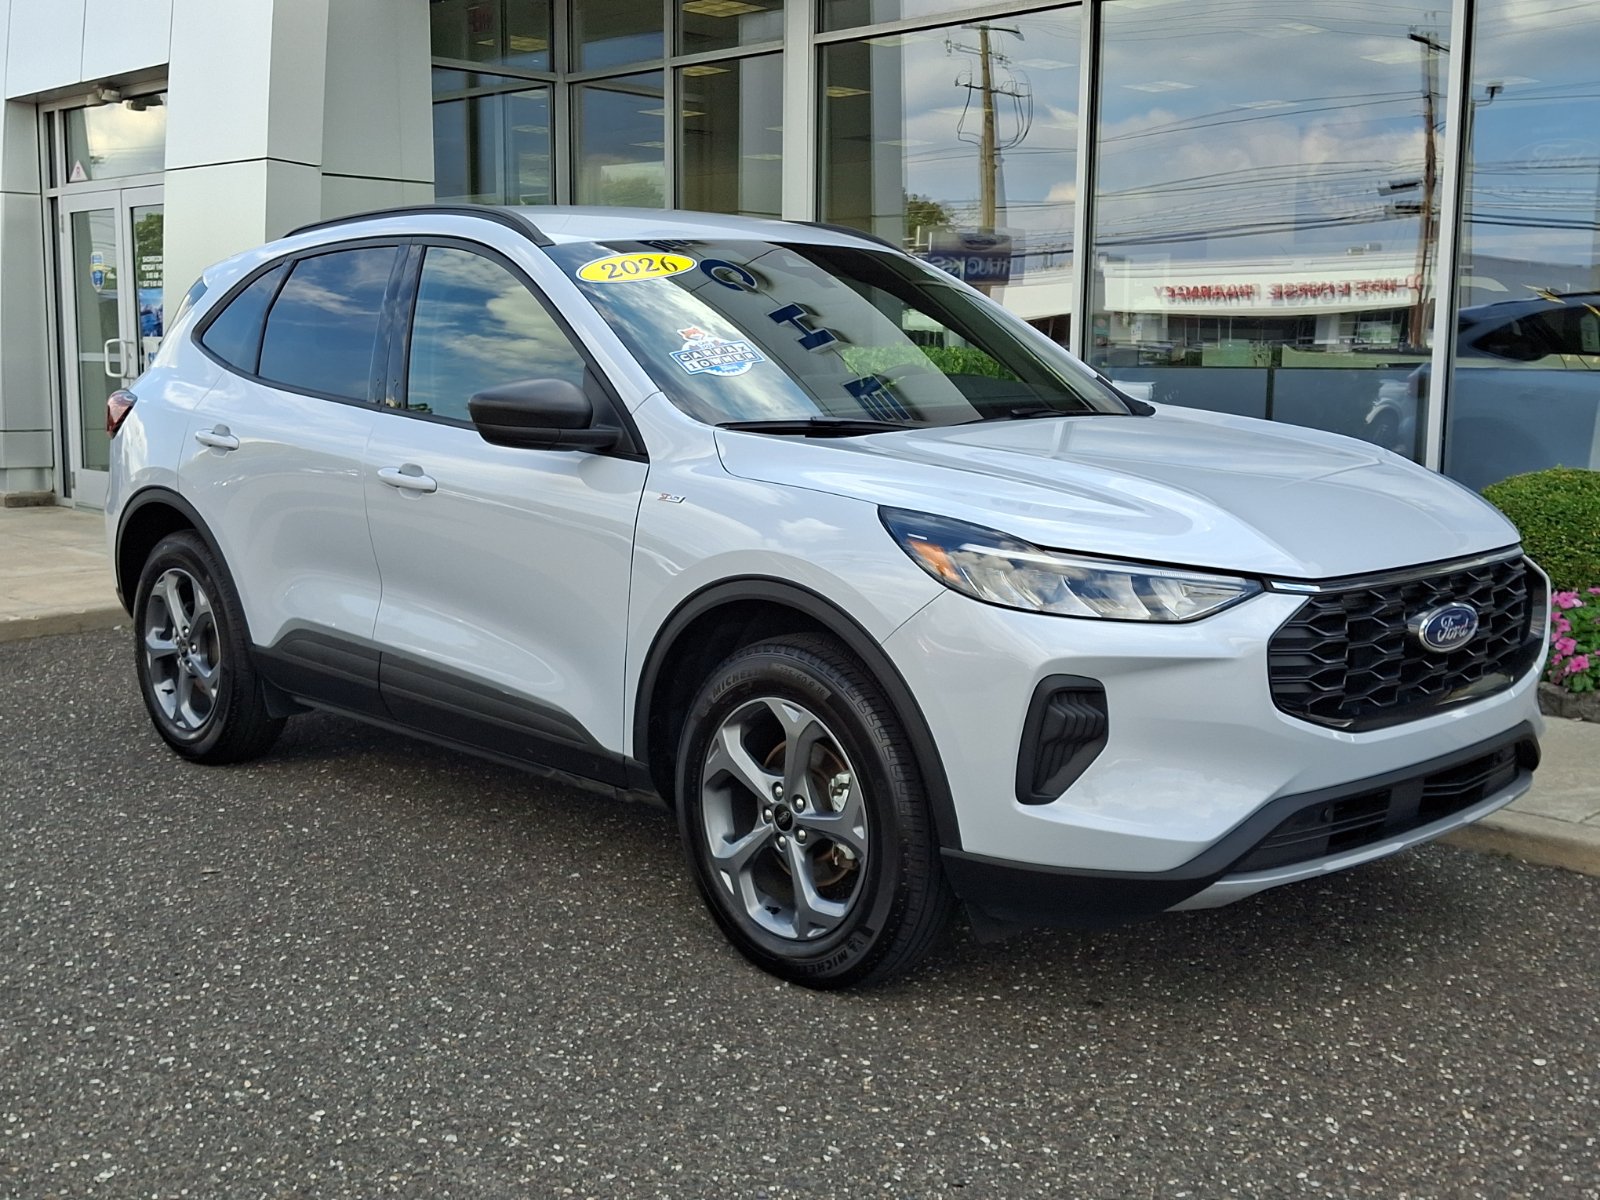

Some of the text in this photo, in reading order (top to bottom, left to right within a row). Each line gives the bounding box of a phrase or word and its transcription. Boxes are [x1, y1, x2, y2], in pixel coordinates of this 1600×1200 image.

[601, 256, 678, 279] 2026
[680, 345, 748, 361] CARFAX
[700, 352, 756, 368] OWNER
[1437, 614, 1469, 642] Ford
[795, 948, 850, 974] MICHEL
